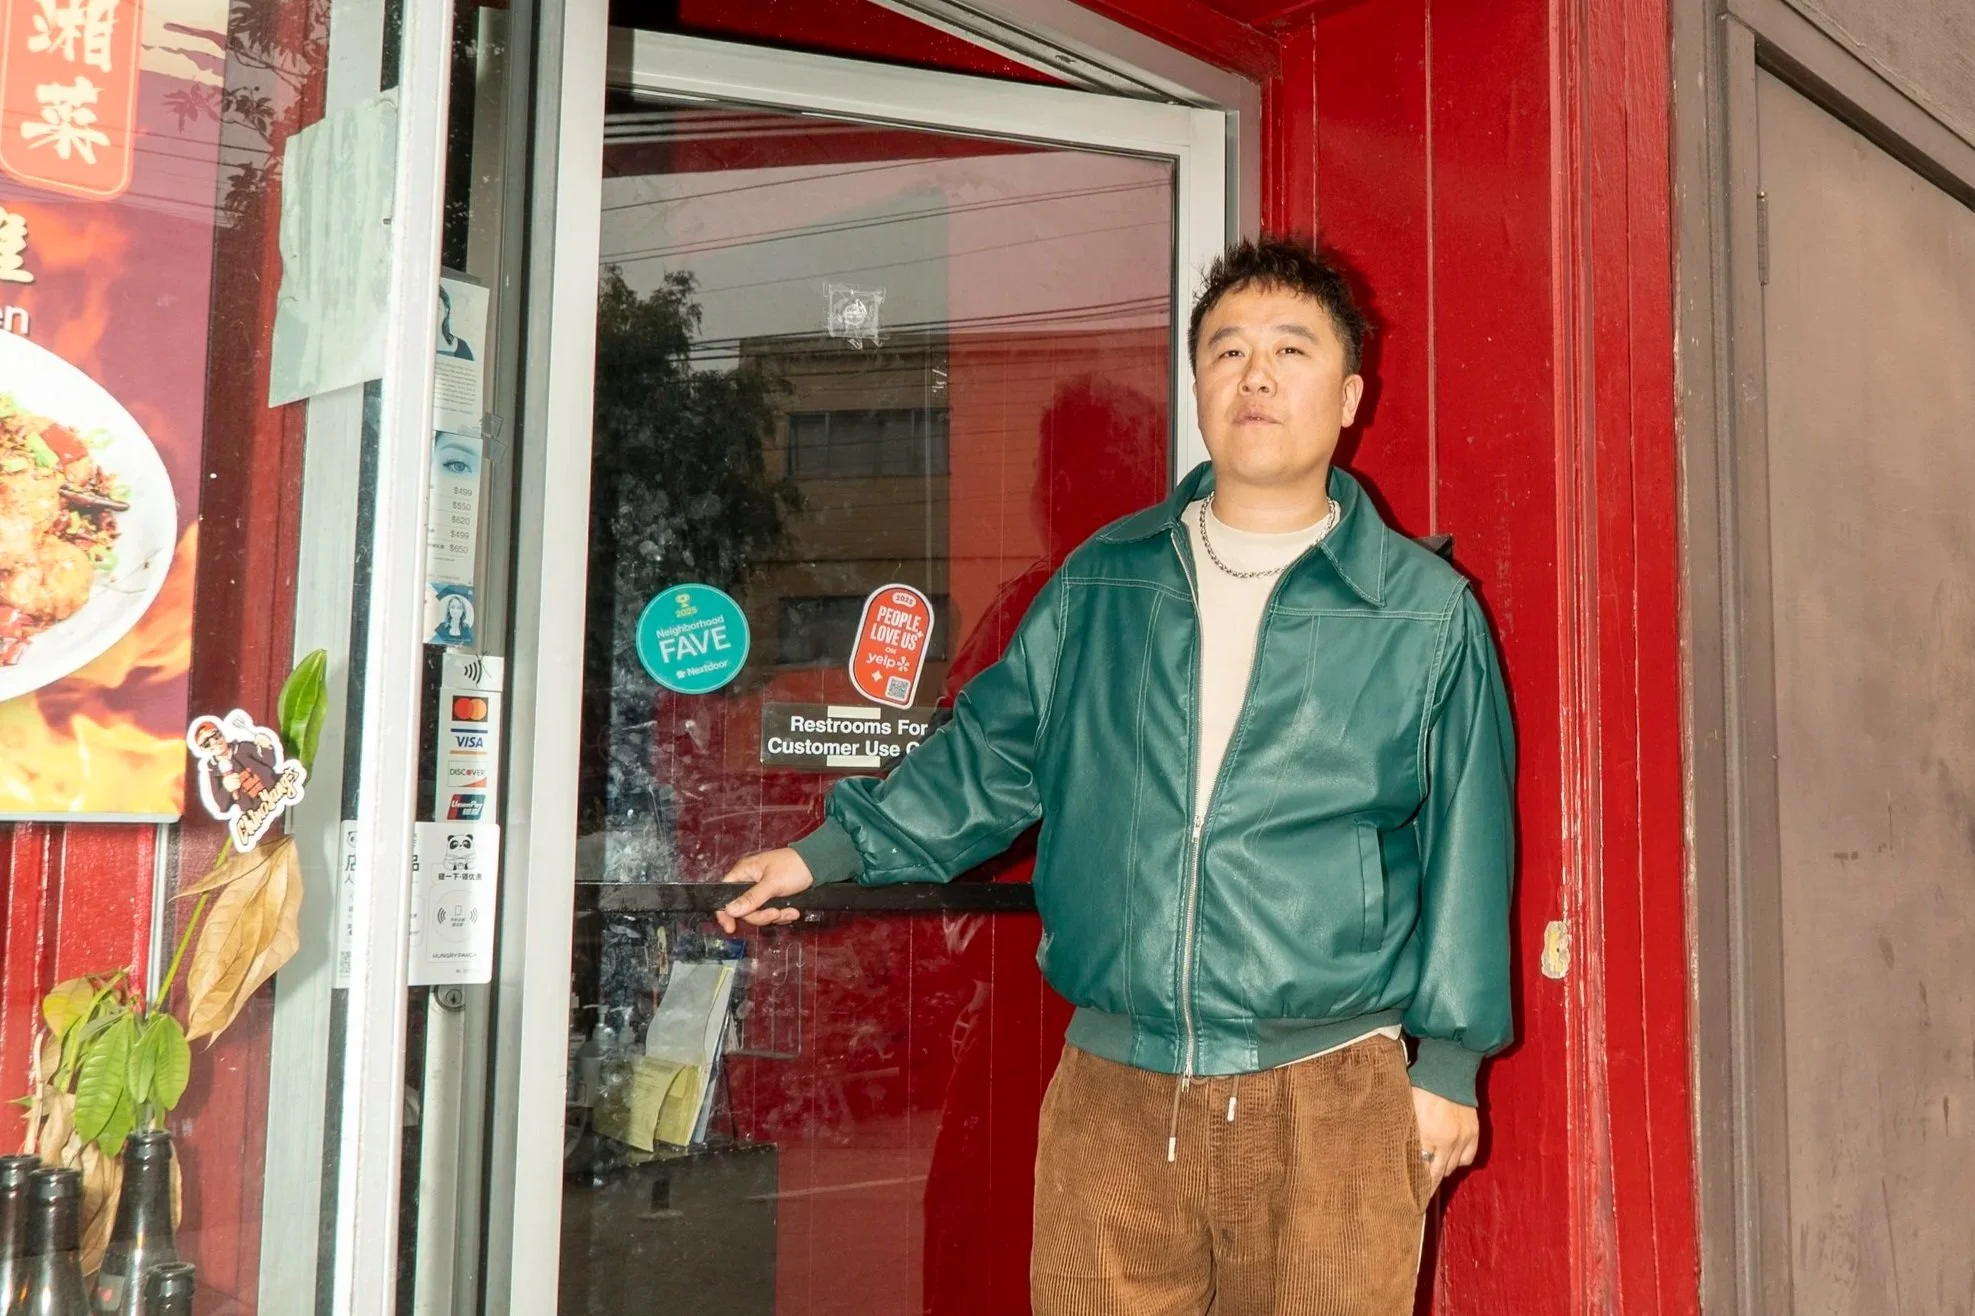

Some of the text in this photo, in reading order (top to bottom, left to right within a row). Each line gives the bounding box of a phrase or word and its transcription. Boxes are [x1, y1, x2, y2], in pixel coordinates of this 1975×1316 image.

[20, 0, 115, 165] 湘菜
[893, 594, 915, 605] 2025
[675, 606, 697, 618] 2025
[876, 606, 922, 632] PEOPLE
[656, 614, 725, 639] Neighborhood
[659, 625, 731, 664] FAVE
[870, 623, 918, 651] LOVE US
[884, 646, 897, 655] ON
[686, 660, 728, 677] Nextdoor
[866, 652, 897, 669] yelp
[790, 715, 929, 736] Restrooms For
[455, 735, 484, 748] VISA
[767, 737, 860, 756] Customer
[865, 740, 900, 757] Use
[449, 768, 485, 776] DISCOVER
